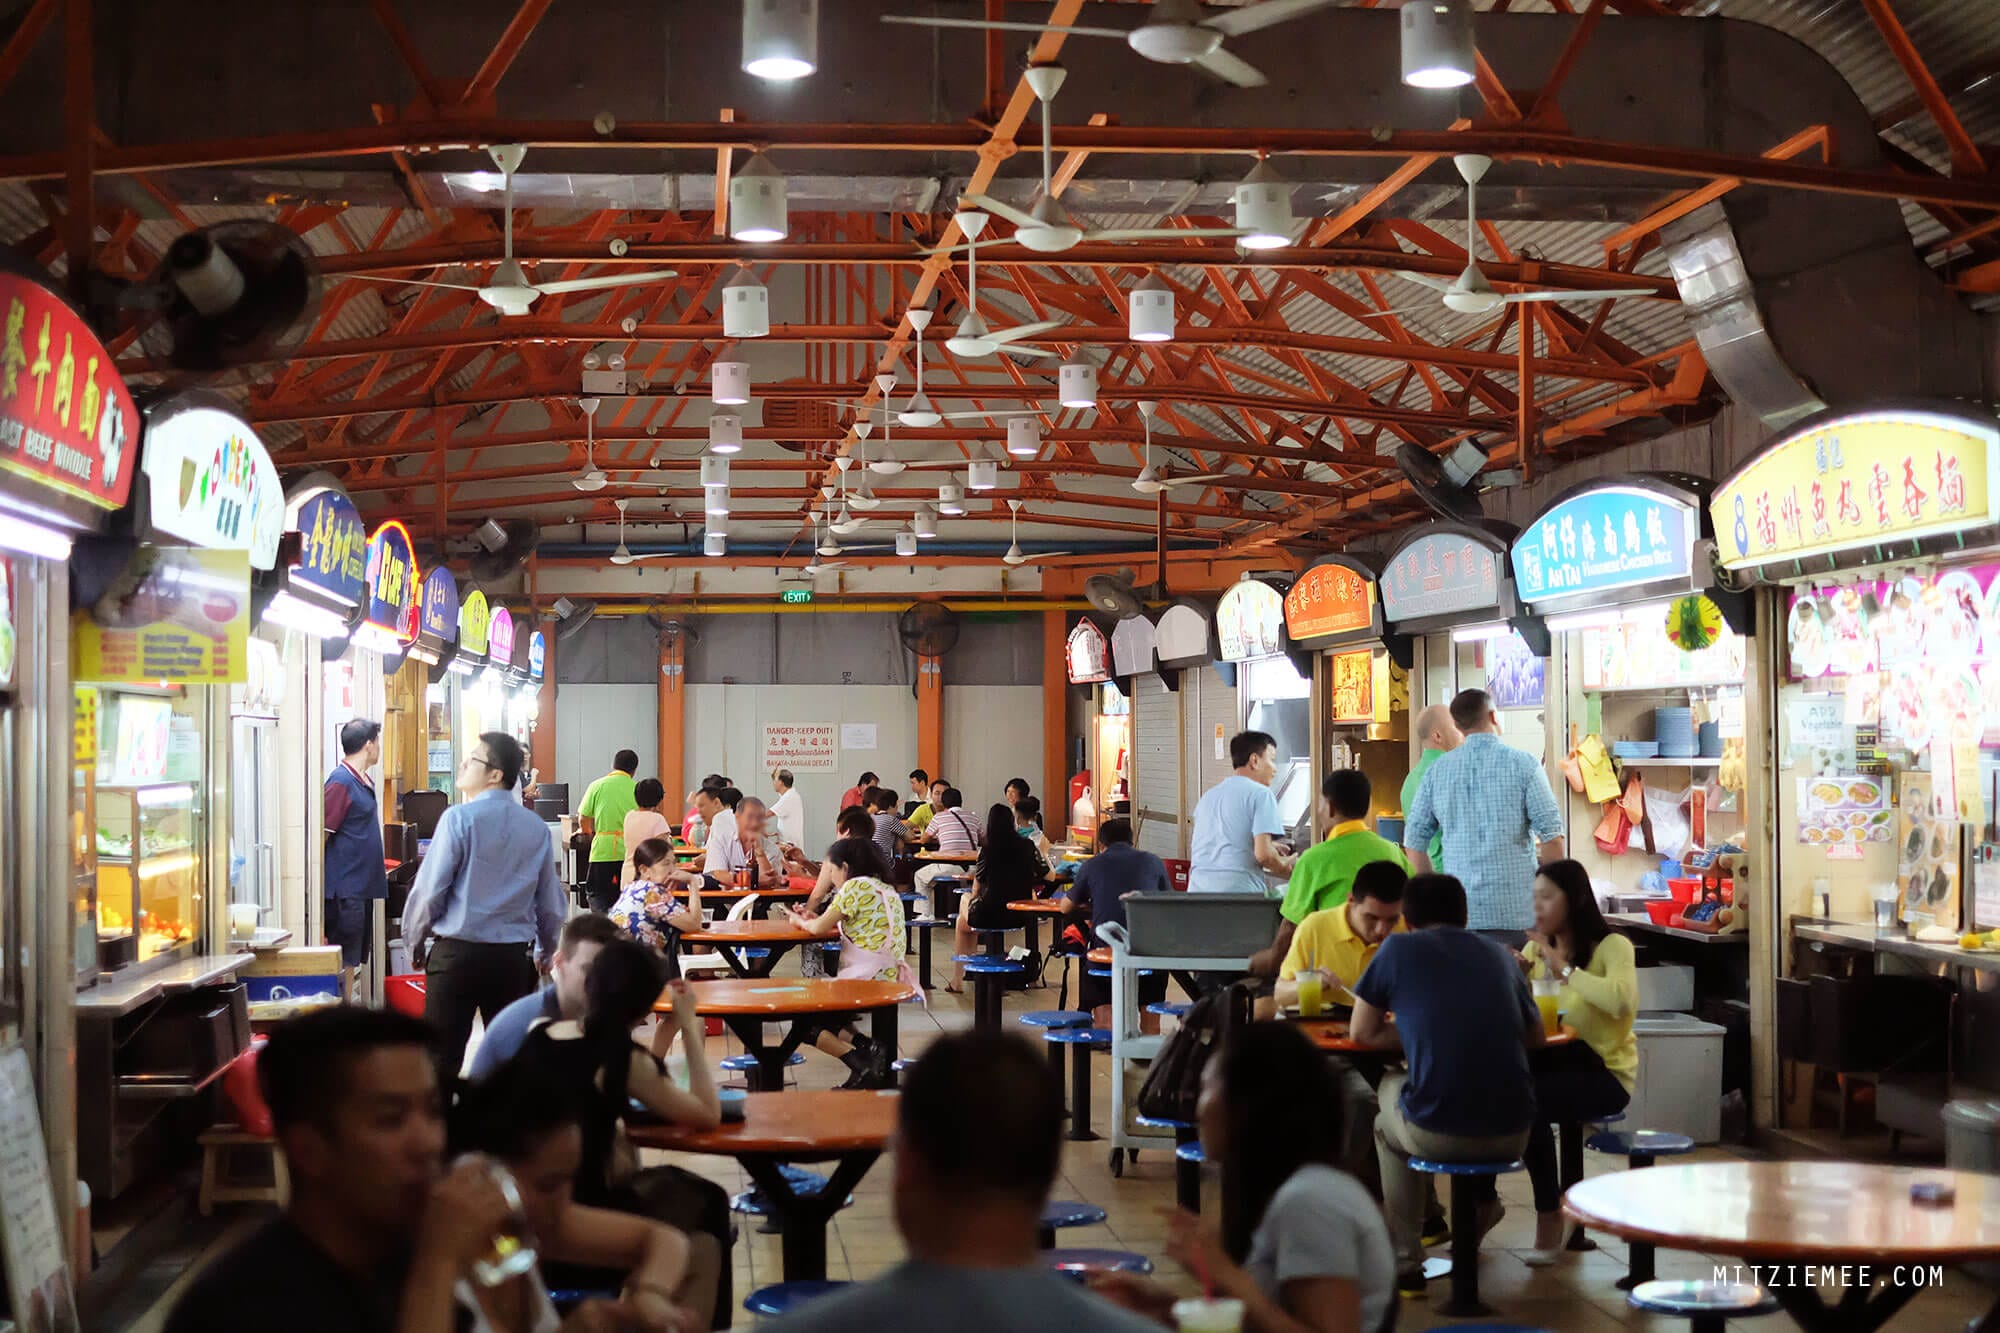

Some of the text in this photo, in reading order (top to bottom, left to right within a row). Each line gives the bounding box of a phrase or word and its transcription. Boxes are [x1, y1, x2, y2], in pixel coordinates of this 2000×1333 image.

[24, 427, 54, 462] BEEF
[54, 441, 93, 481] NOODLE
[788, 591, 807, 603] EXIT
